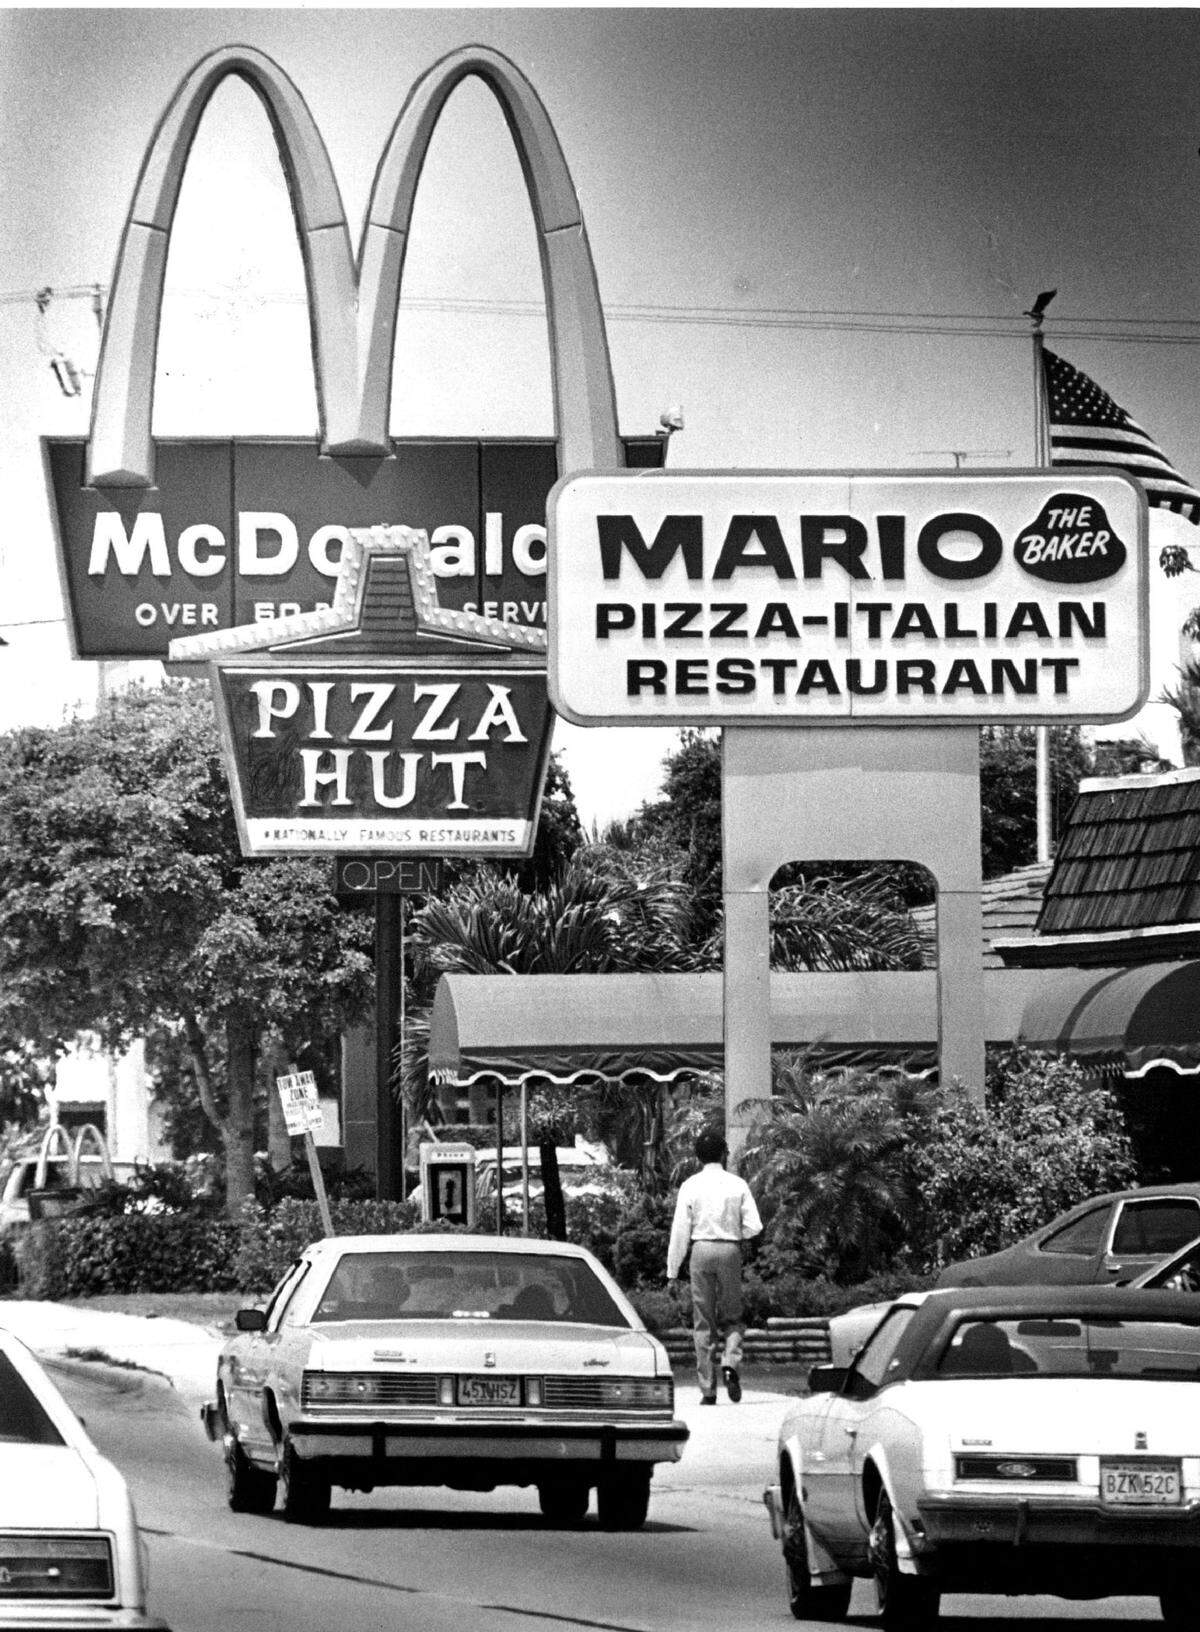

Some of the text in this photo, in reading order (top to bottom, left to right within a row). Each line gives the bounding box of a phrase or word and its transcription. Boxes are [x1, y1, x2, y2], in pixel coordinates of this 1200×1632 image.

[1047, 506, 1092, 529] THE
[88, 511, 547, 577] McDoal
[596, 512, 1003, 580] MARIO
[1021, 530, 1110, 565] BAKER
[135, 602, 218, 626] OVER
[596, 602, 1106, 639] PIZZA-ITALIAN
[626, 658, 1079, 696] RESTAURANT
[249, 680, 528, 742] PIZZA
[297, 750, 487, 809] HUT
[273, 829, 516, 842] NATIONALLY FAMOUS RESTAURANTS
[342, 861, 439, 890] OPEN
